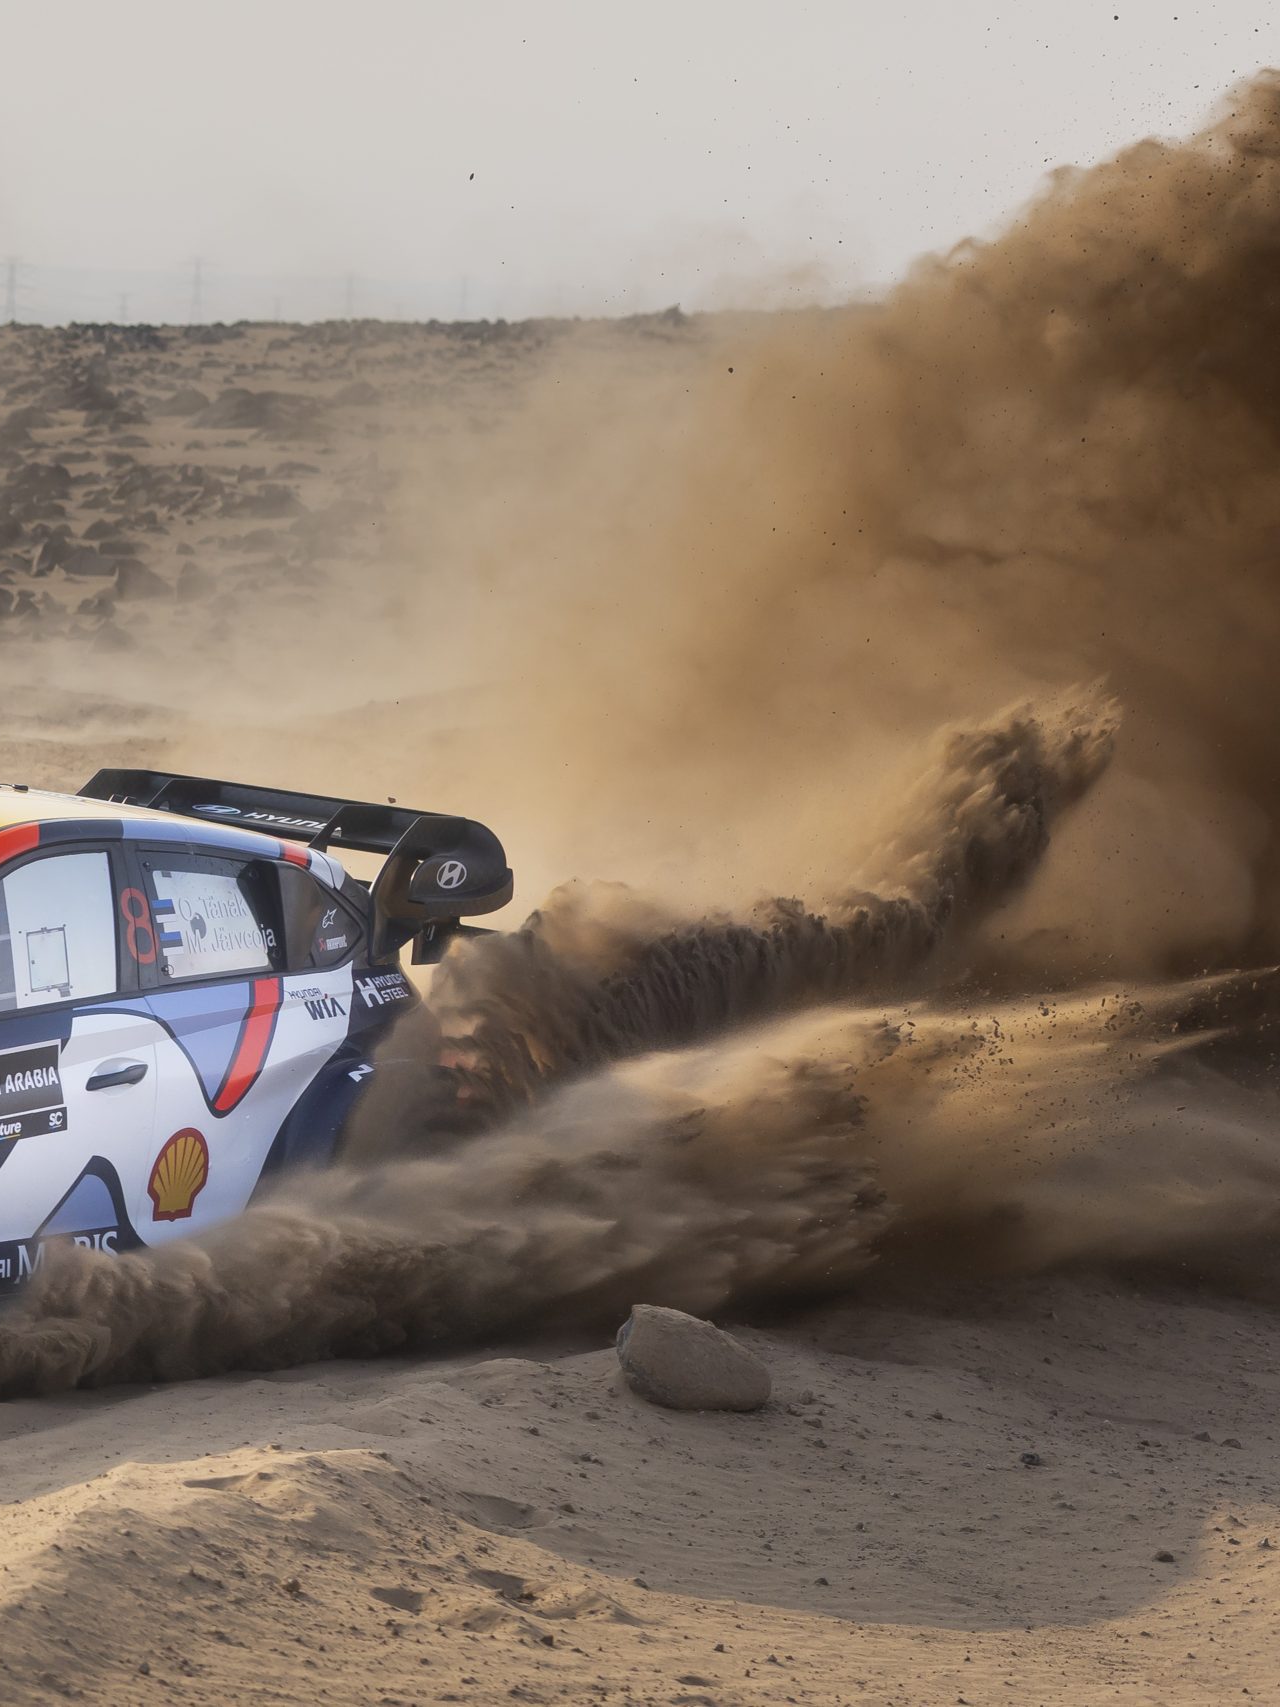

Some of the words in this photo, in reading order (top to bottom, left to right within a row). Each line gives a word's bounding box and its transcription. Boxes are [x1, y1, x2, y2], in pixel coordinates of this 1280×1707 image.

[121, 887, 159, 964] 8
[380, 986, 409, 1002] STEEL
[5, 1066, 59, 1095] ARABIA
